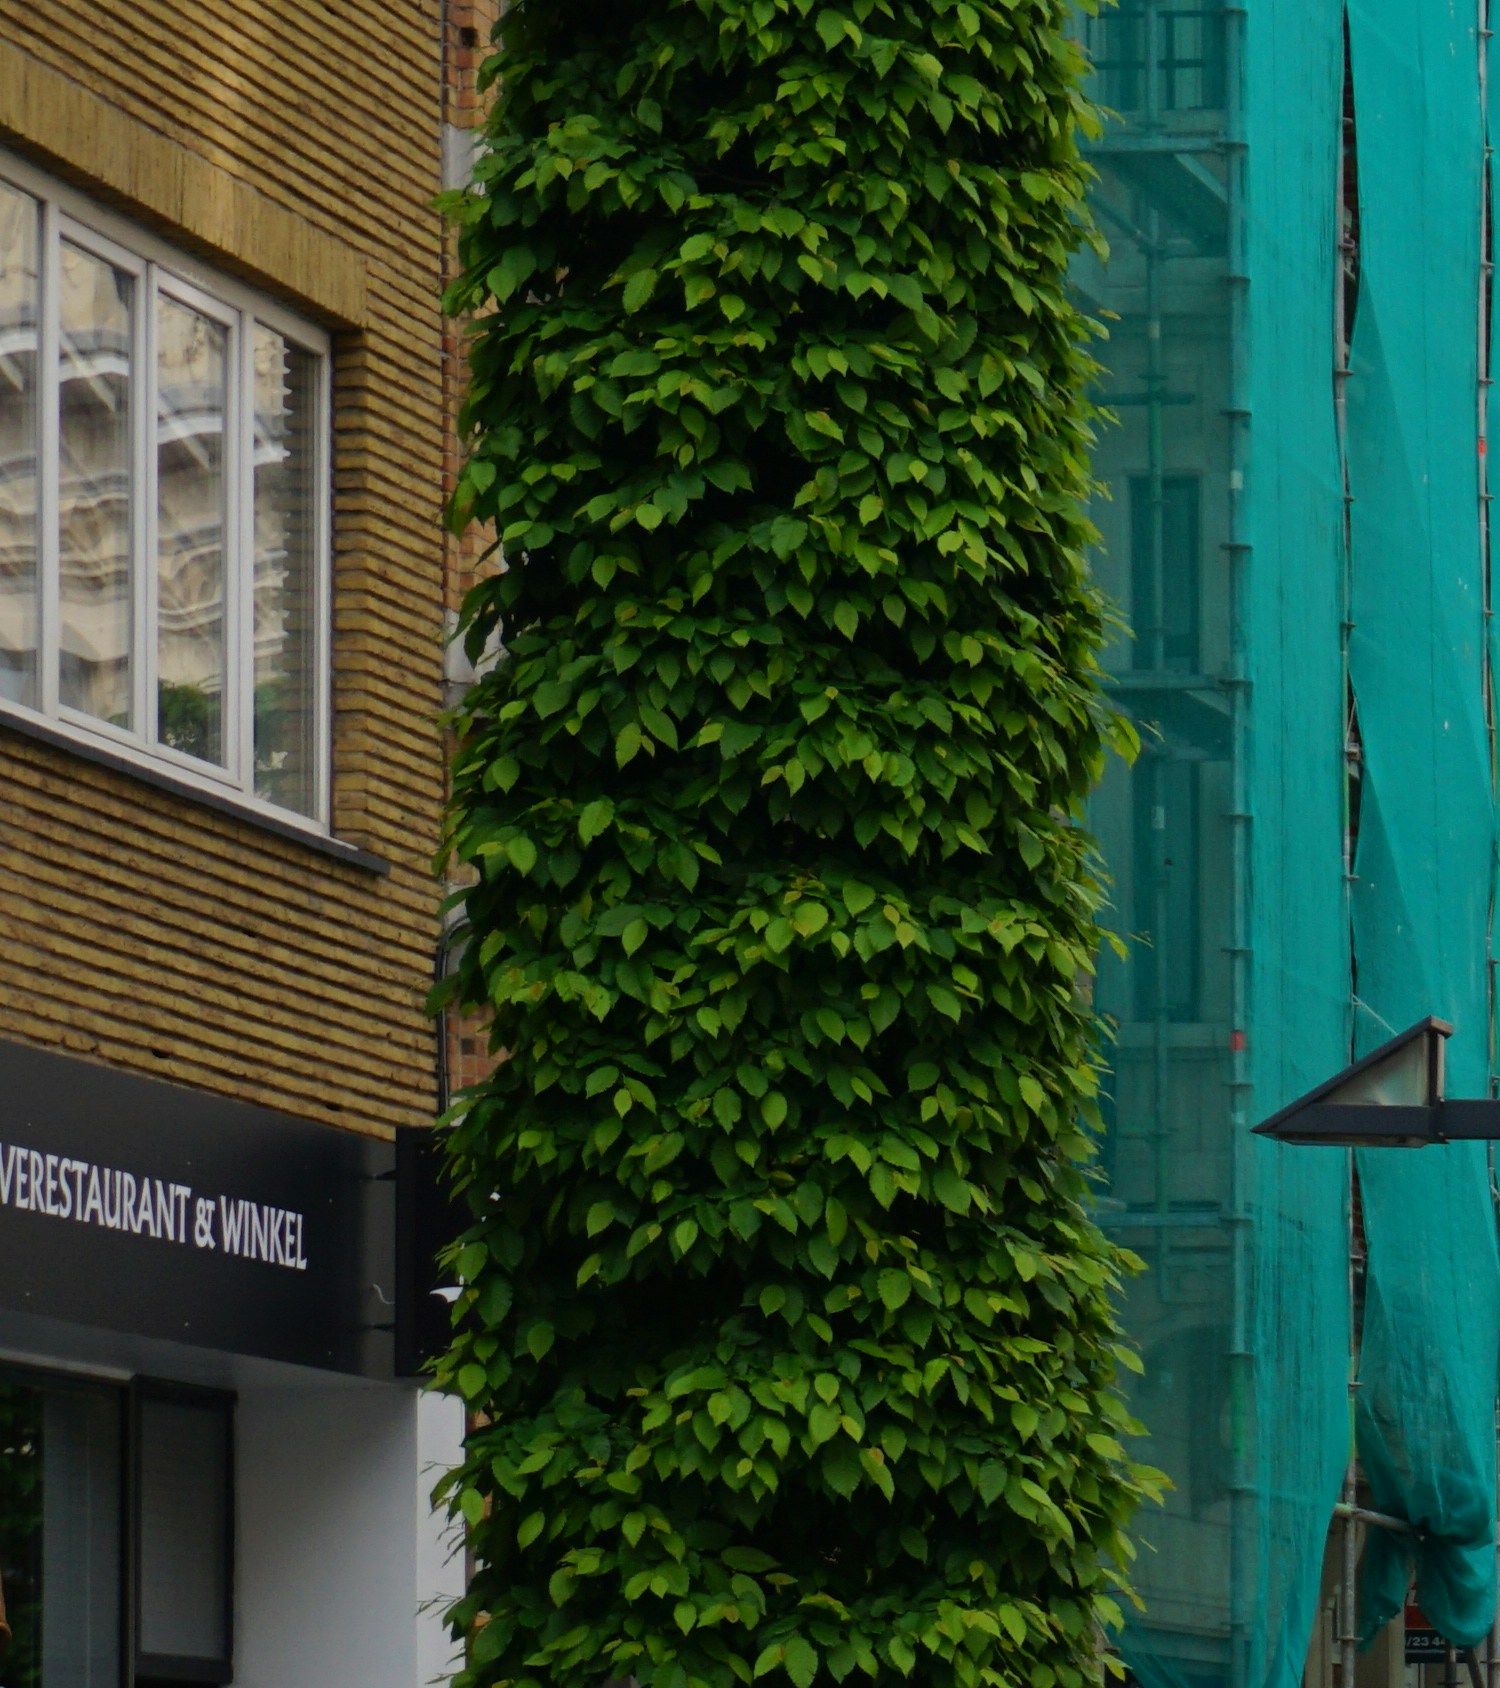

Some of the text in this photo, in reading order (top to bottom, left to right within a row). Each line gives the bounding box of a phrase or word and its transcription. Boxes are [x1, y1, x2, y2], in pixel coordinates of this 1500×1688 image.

[194, 1197, 216, 1250] &
[219, 1195, 308, 1270] WINKEL
[1406, 1636, 1430, 1647] /23
